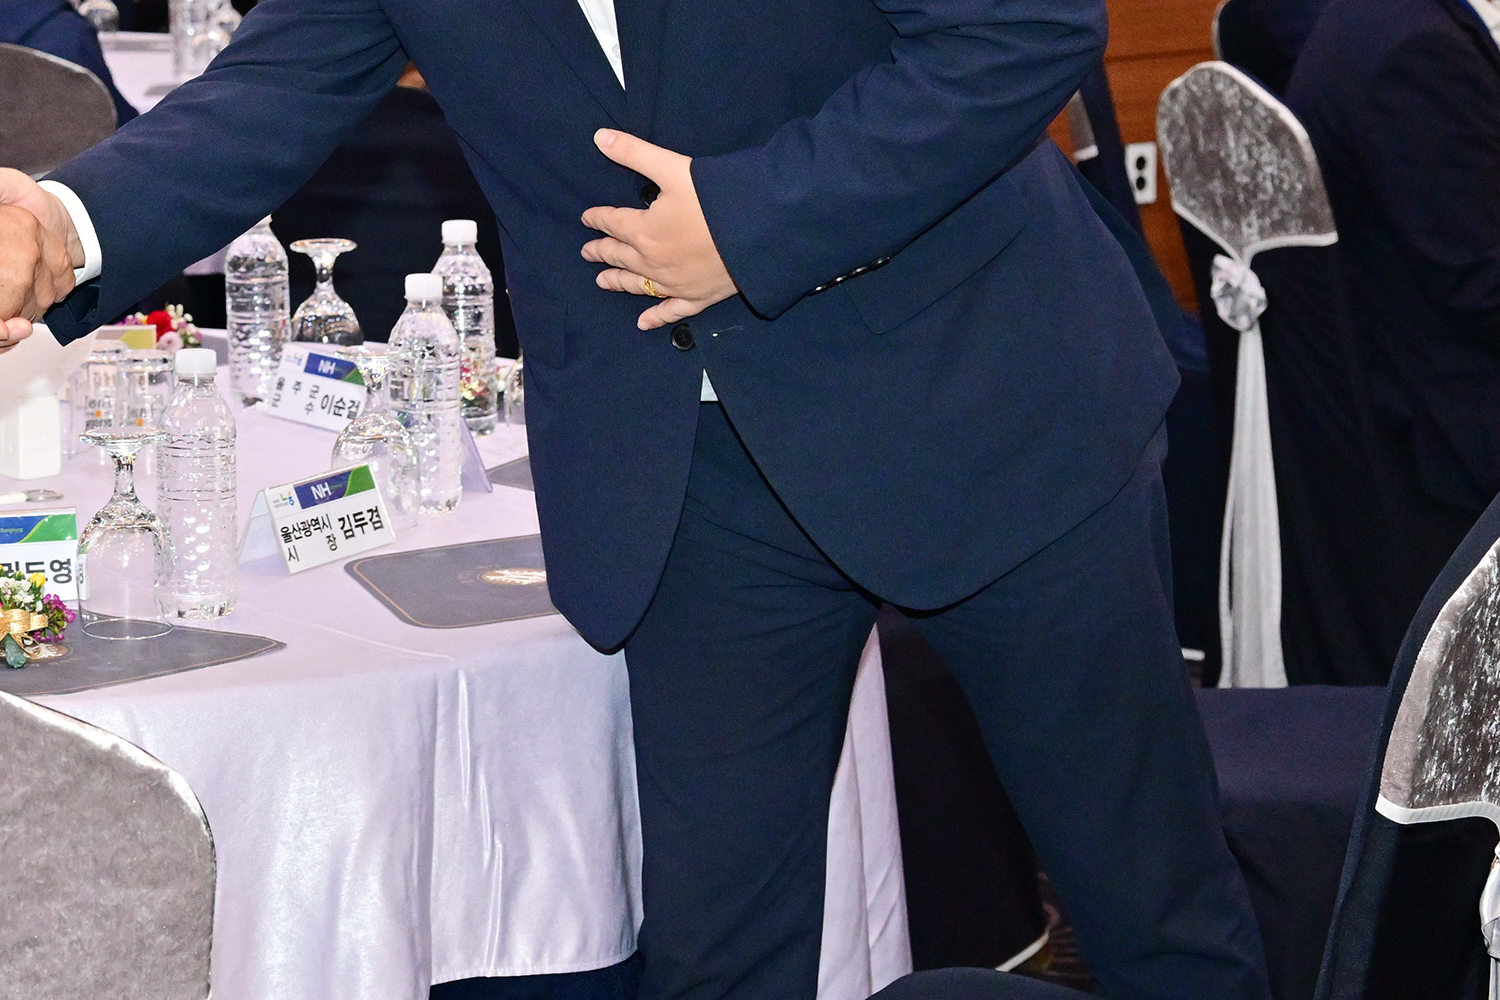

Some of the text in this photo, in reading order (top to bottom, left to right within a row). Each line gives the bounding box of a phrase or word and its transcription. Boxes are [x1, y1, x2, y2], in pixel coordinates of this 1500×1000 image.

[317, 359, 336, 375] NH
[310, 482, 332, 500] NH
[280, 505, 385, 543] 울산광역시 김두겸
